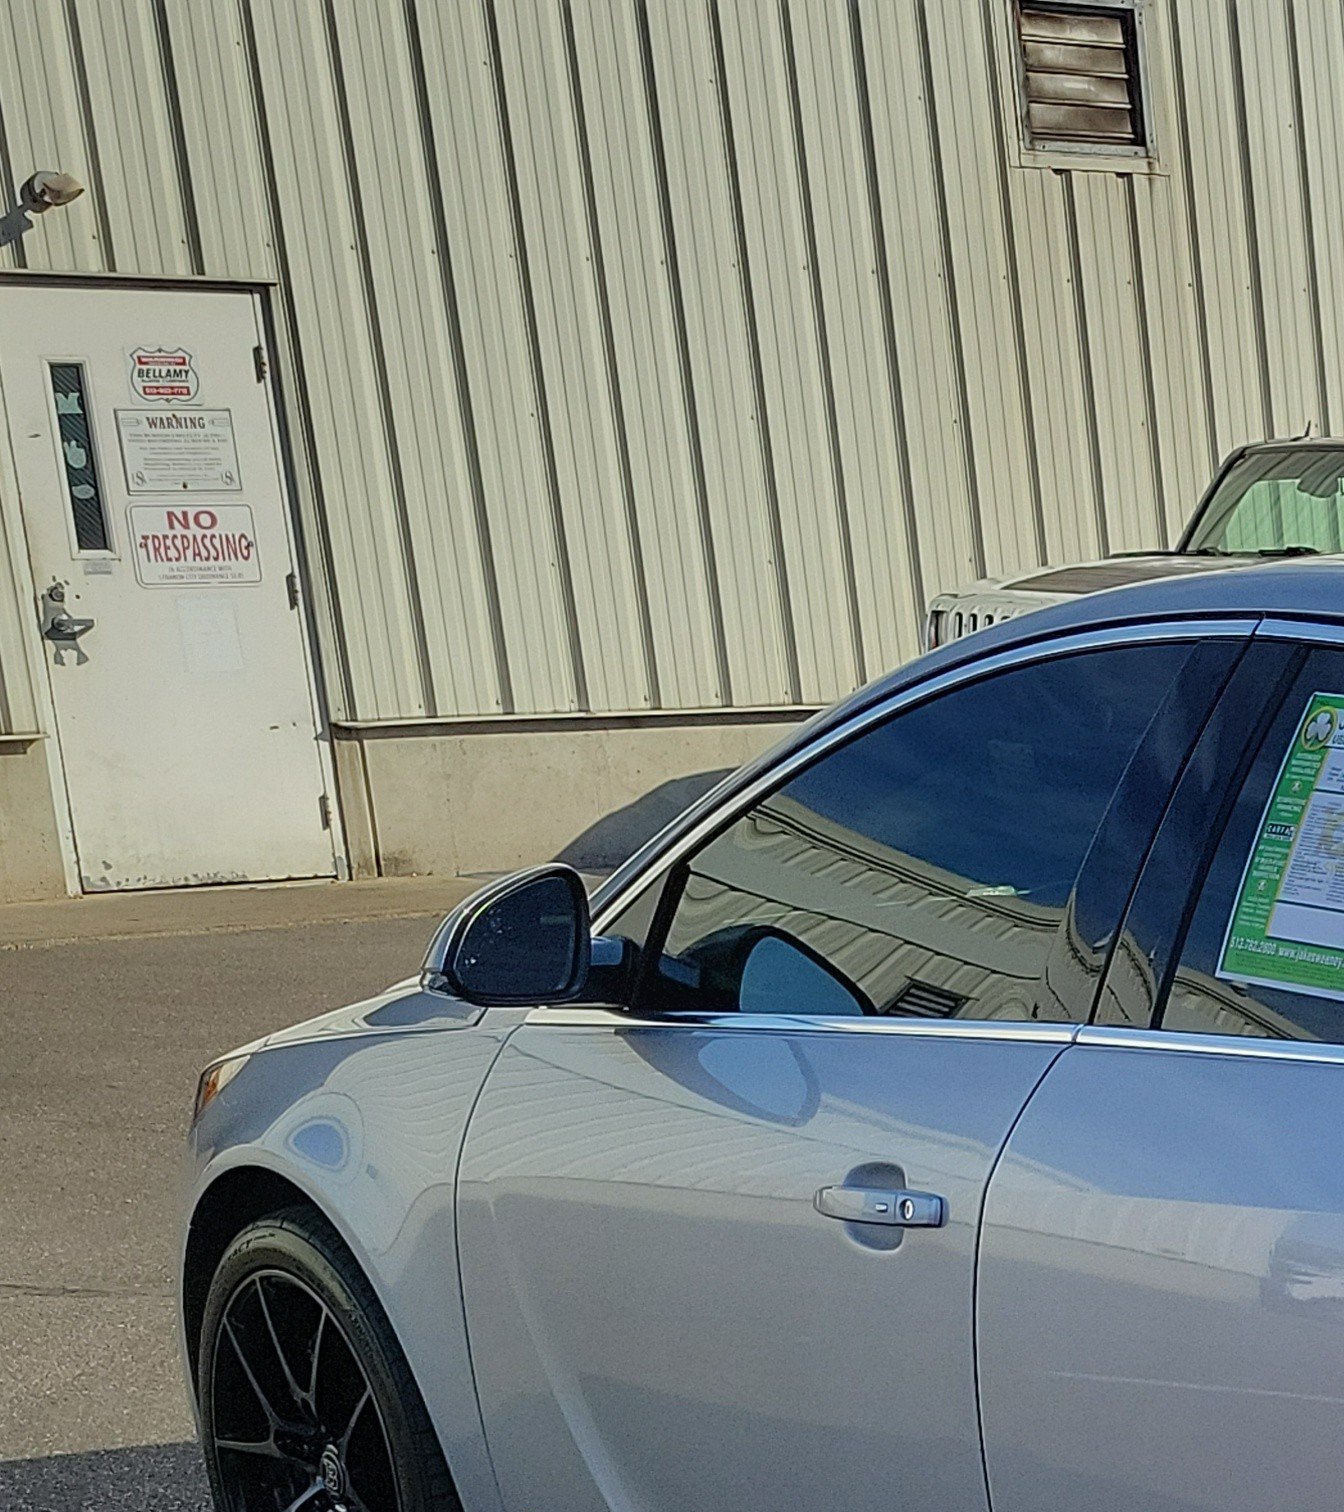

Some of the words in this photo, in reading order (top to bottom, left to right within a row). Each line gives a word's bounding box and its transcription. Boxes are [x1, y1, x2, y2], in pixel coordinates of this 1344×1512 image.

[137, 367, 190, 379] BELLAMY
[145, 416, 206, 429] WARNING
[166, 509, 219, 530] NO
[141, 532, 252, 563] TRESPASSING
